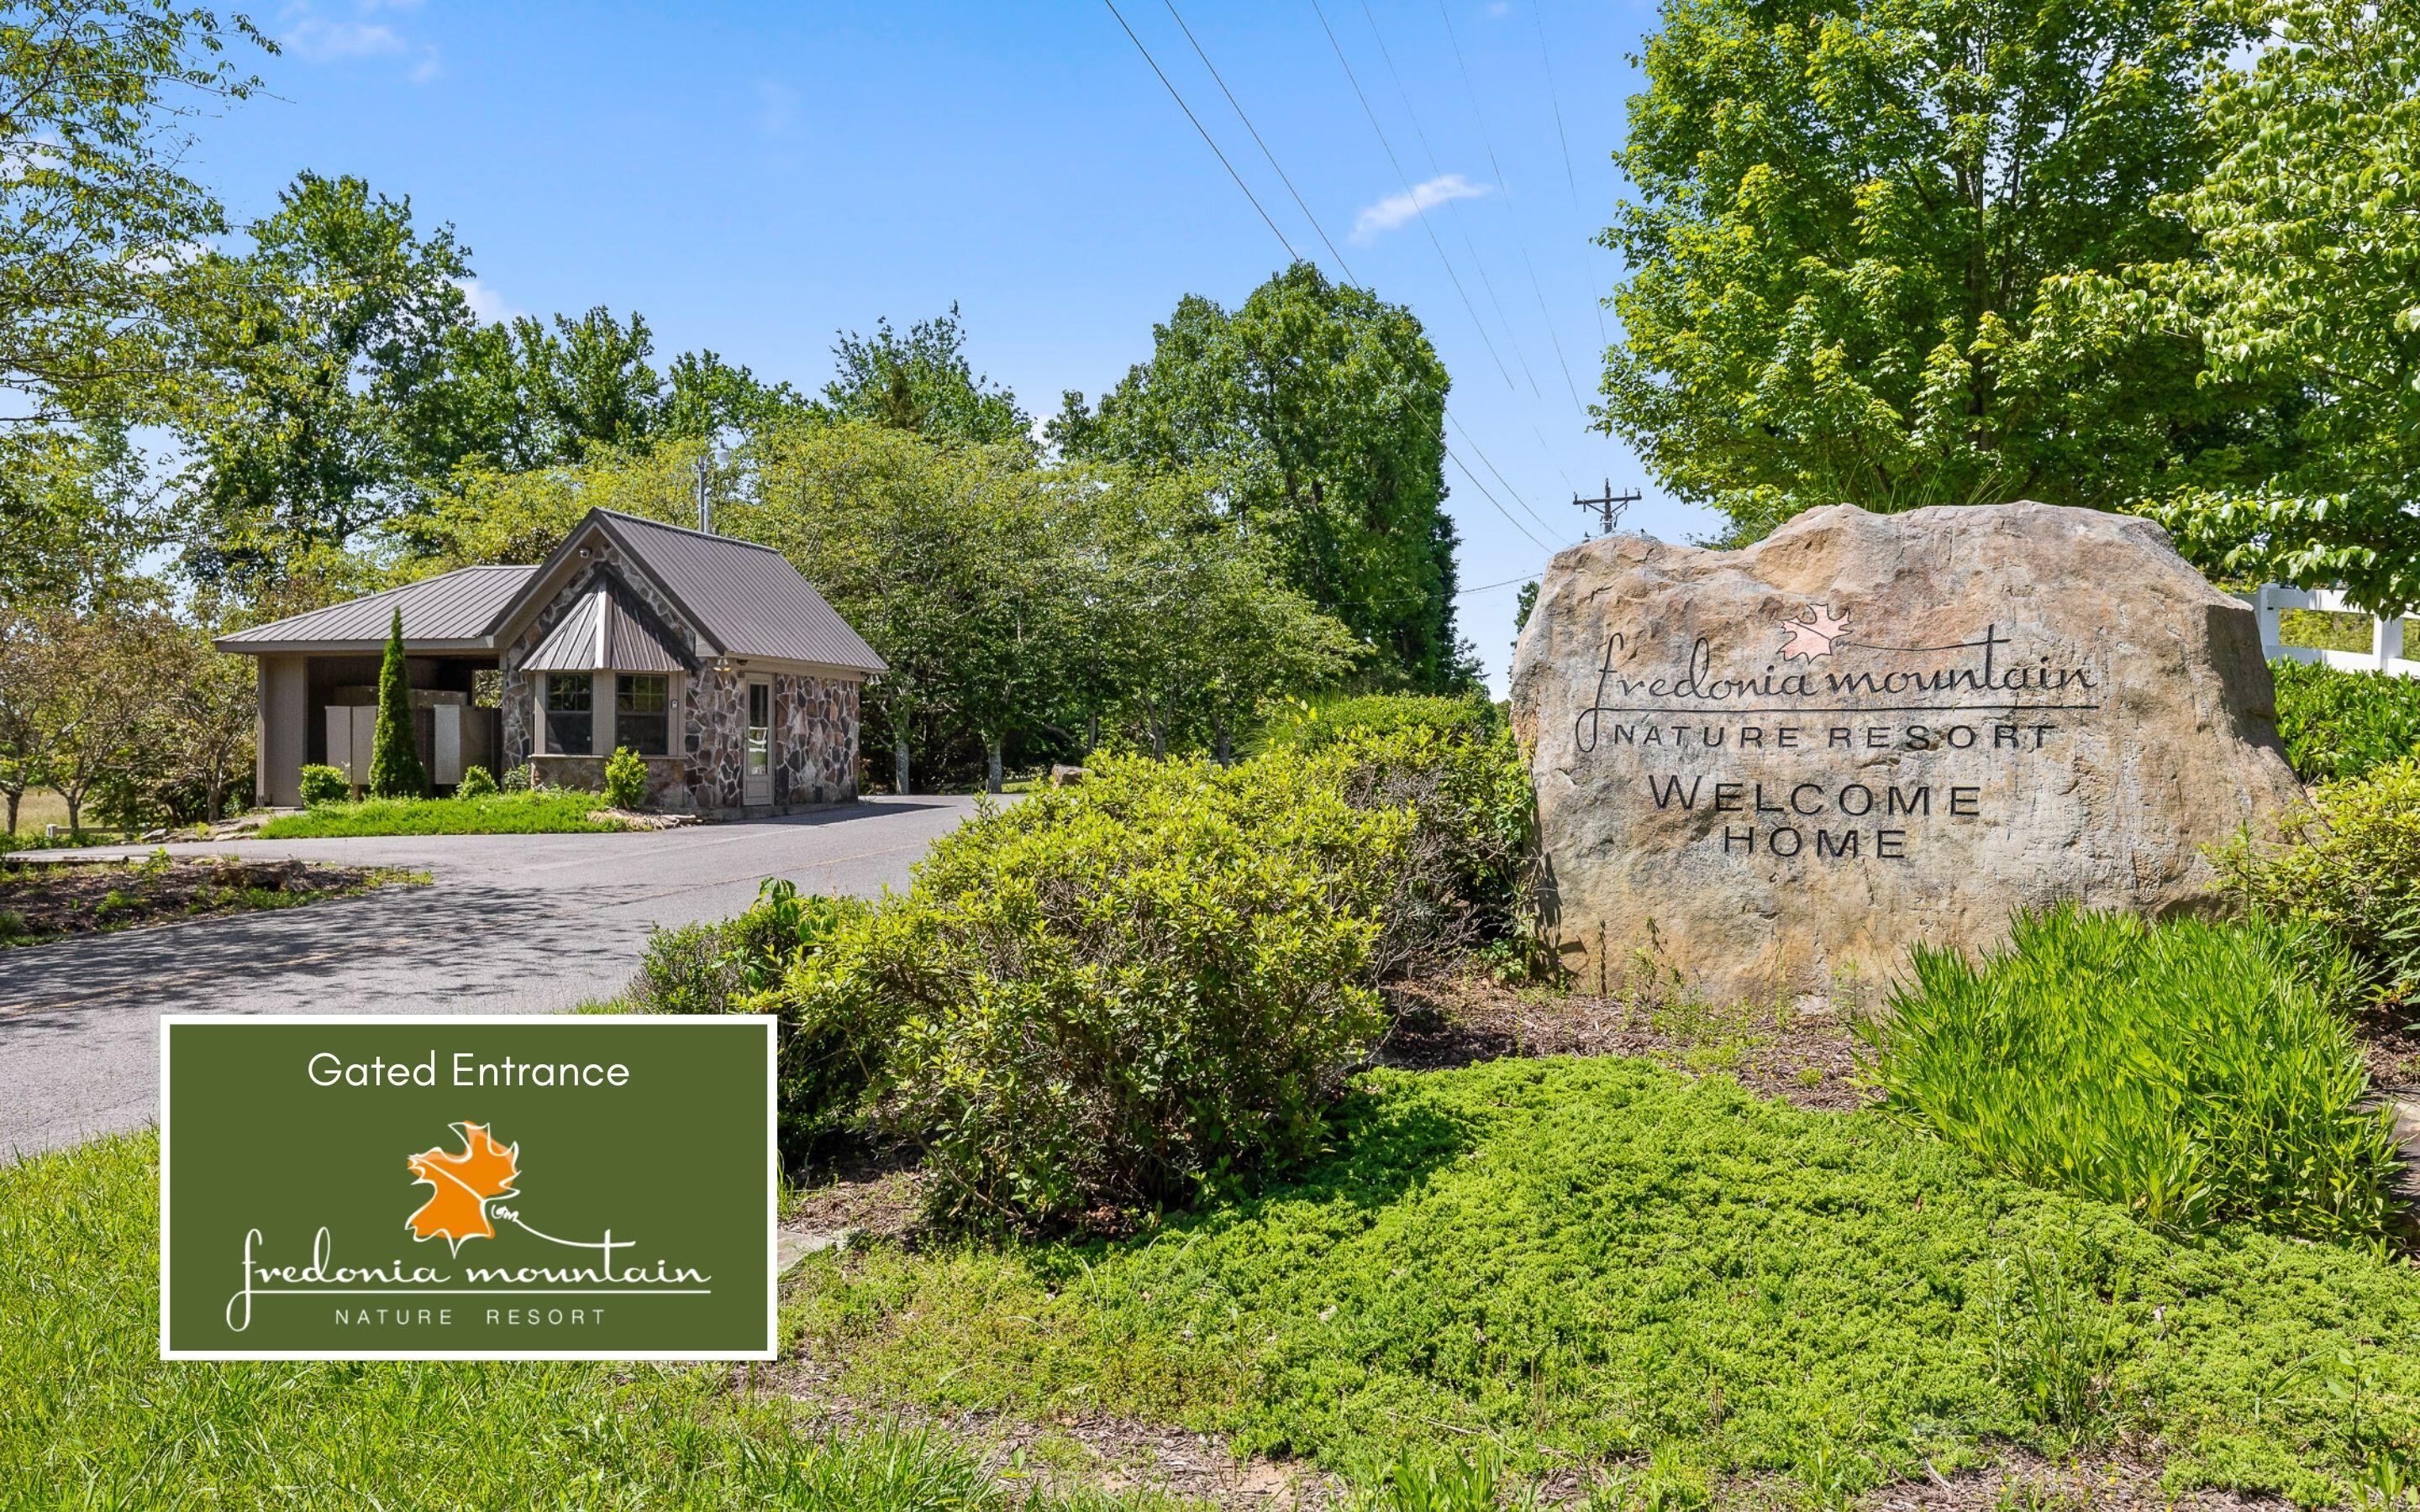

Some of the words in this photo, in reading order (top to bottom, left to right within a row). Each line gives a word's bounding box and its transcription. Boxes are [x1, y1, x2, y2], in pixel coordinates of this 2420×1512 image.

[1575, 633, 1818, 753] fredonia
[1824, 624, 2098, 695] mountain
[1613, 723, 1800, 748] NATURE
[1828, 725, 2057, 750] RESORT
[1648, 774, 1981, 817] WELCOME
[1723, 826, 1906, 858] HOME
